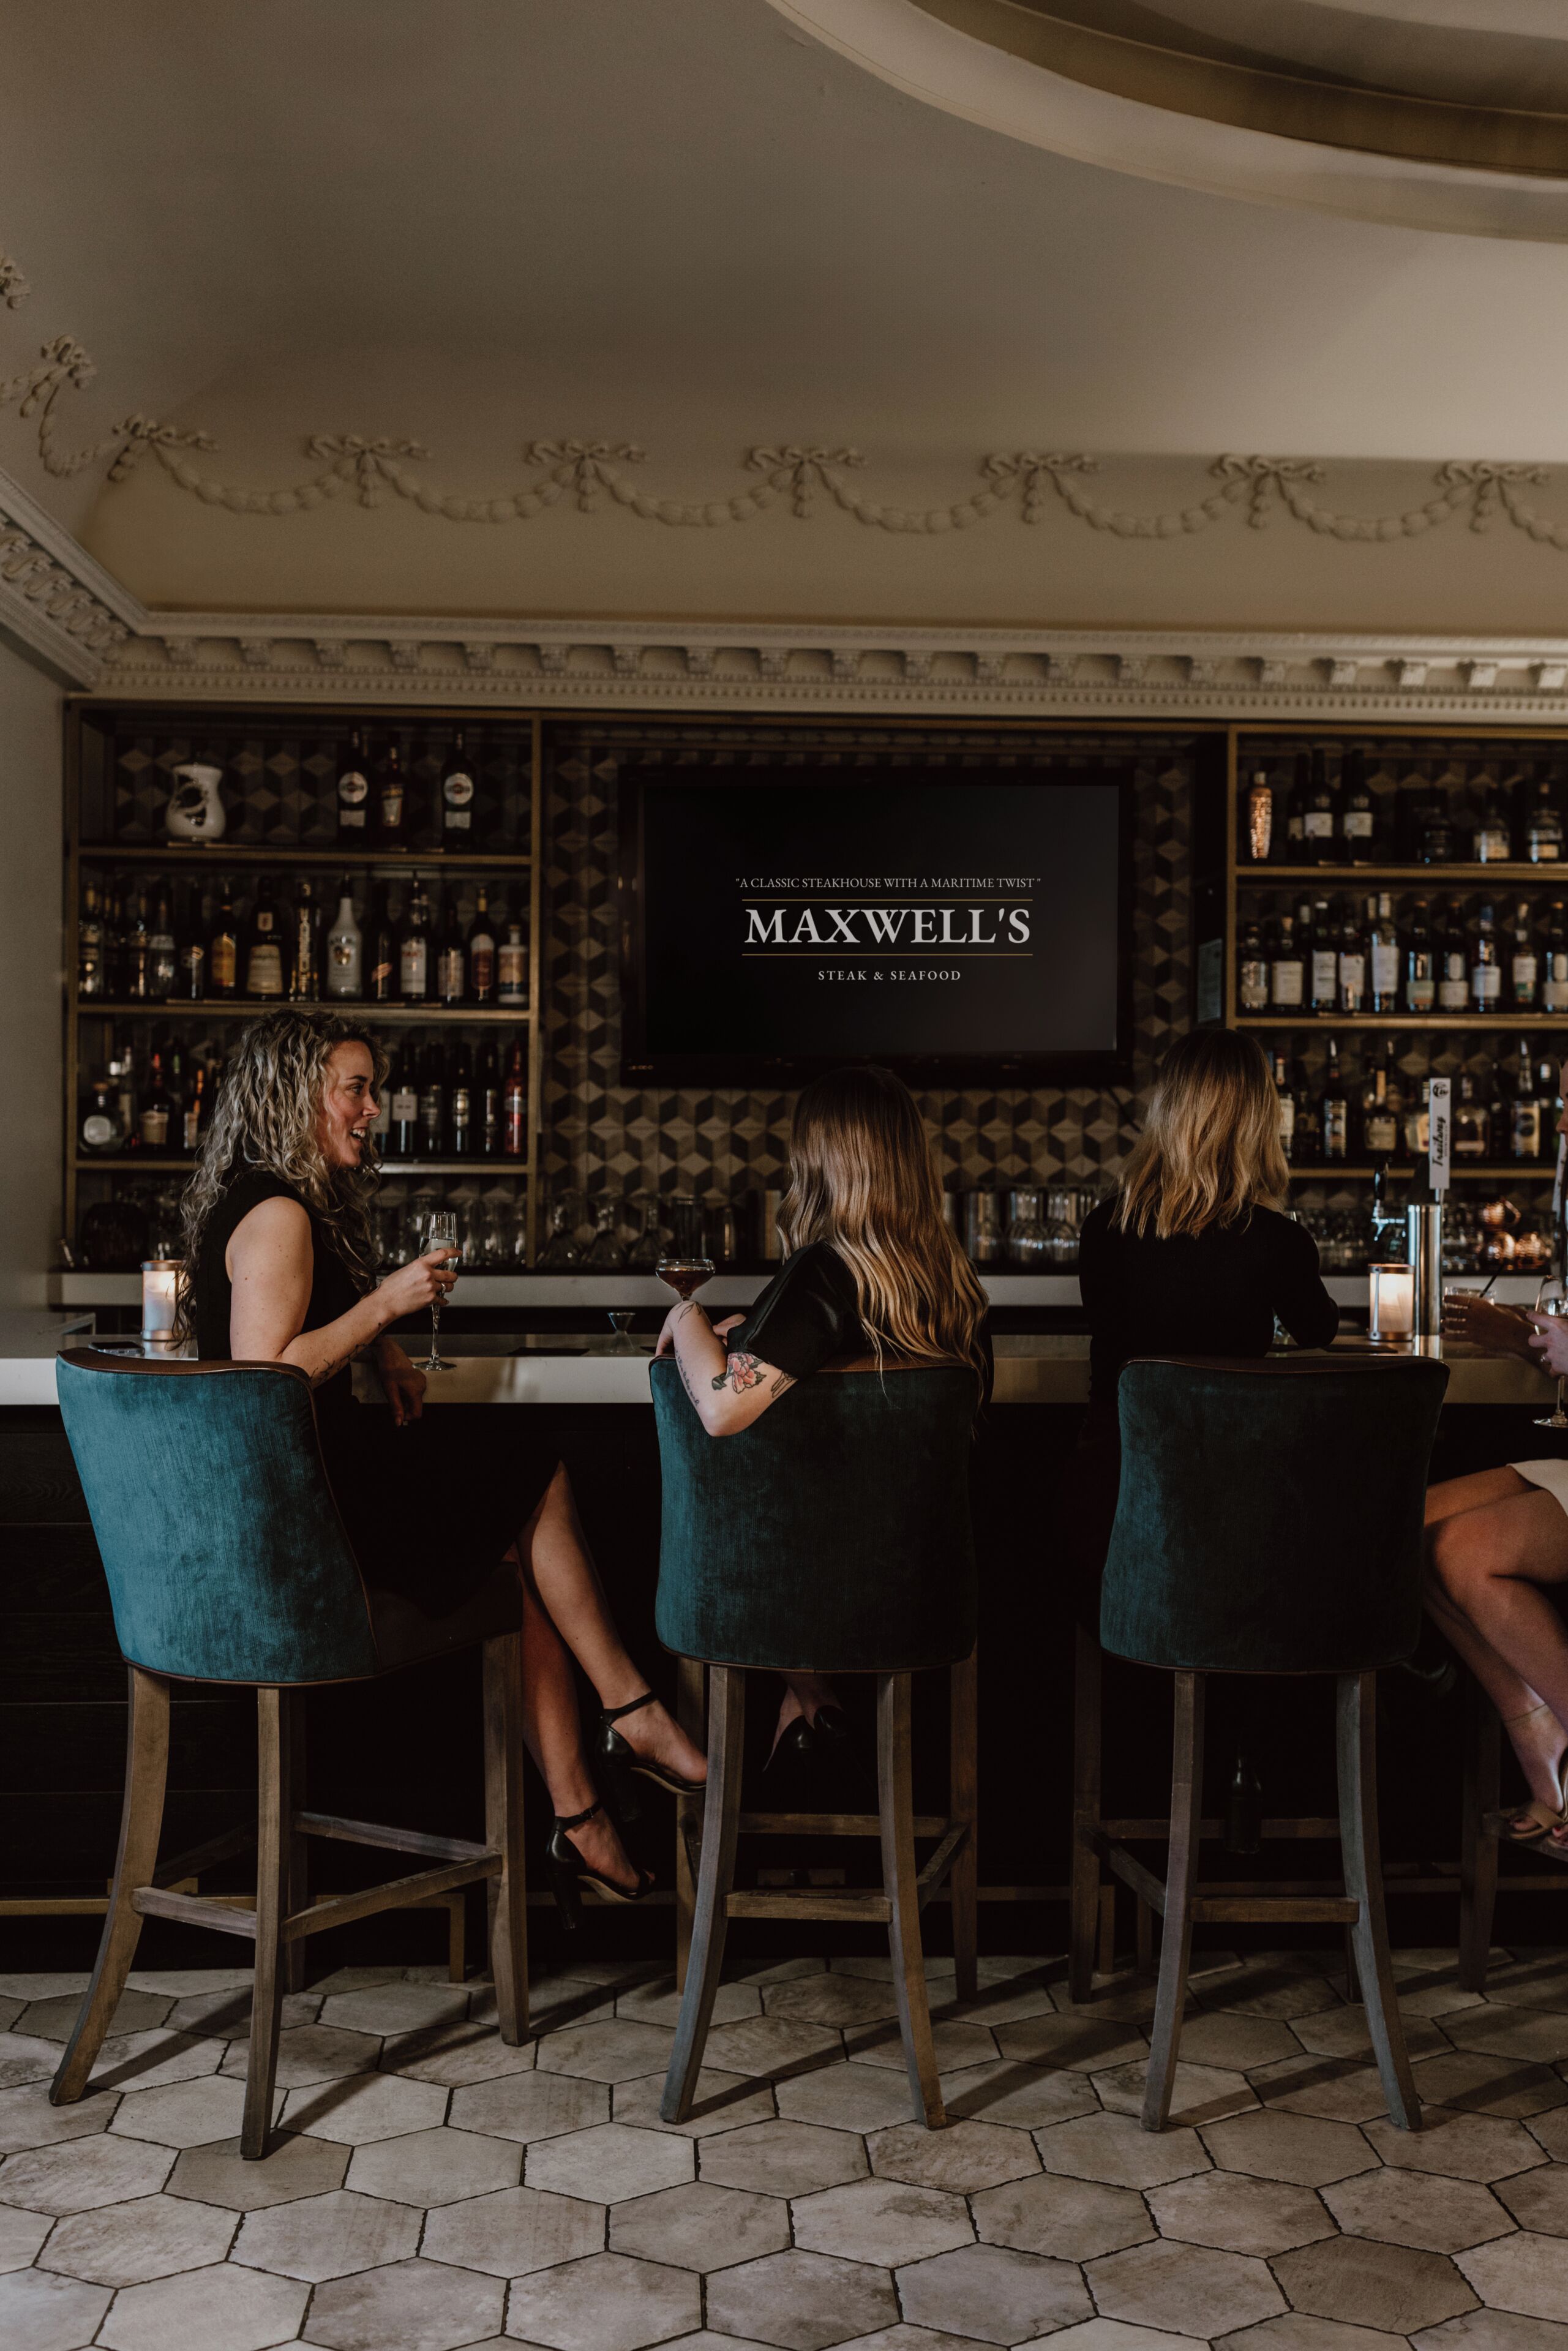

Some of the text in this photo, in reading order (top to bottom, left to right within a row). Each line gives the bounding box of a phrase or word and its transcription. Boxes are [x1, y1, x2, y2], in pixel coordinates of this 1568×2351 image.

[736, 878, 748, 888] "A
[751, 878, 800, 888] CLASSIC
[802, 878, 882, 888] STEAKHOUSE
[883, 878, 917, 888] WITH
[920, 878, 929, 888] A
[931, 878, 994, 888] MARITIME
[744, 908, 1030, 943] MAXWELL'S
[818, 970, 961, 980] STEAK & SEAFOOD
